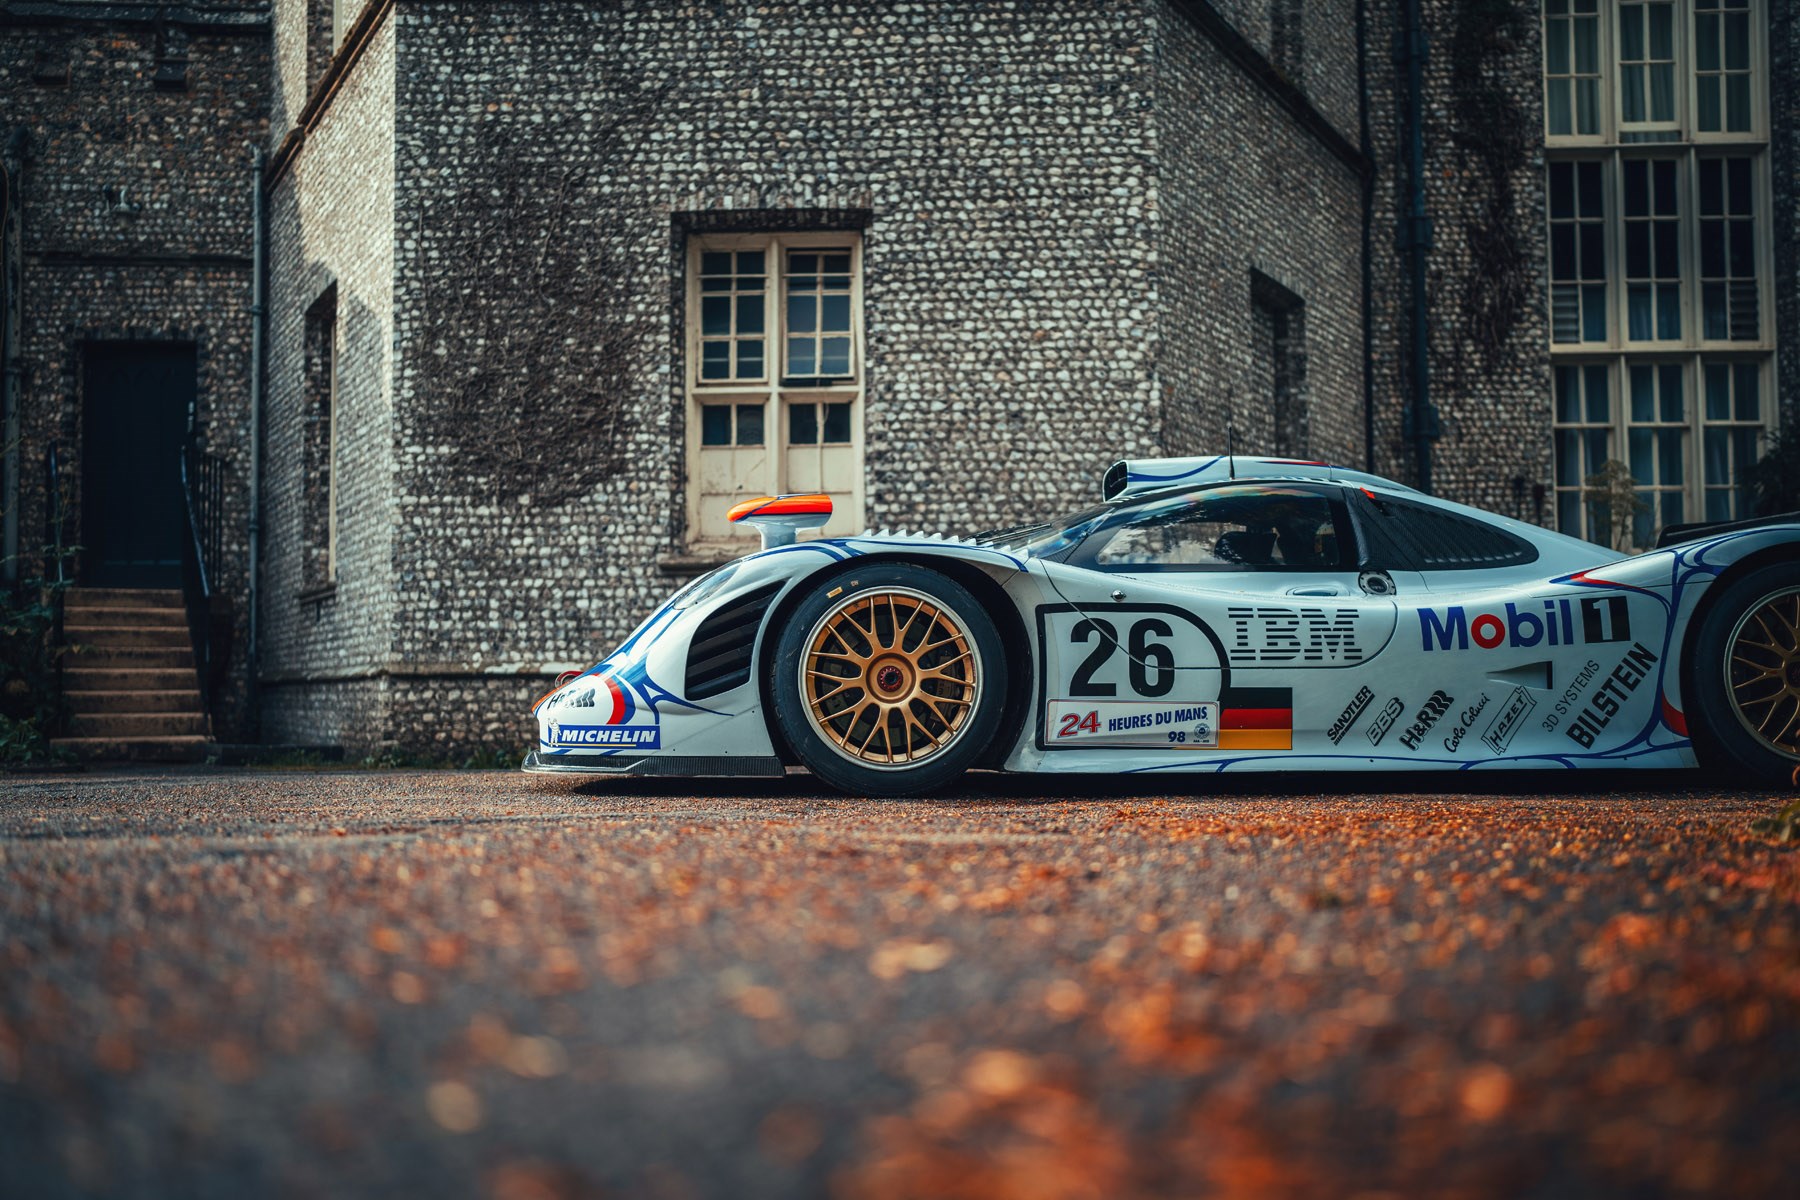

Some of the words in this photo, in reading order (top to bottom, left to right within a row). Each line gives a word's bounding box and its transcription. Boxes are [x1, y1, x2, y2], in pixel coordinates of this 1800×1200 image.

[1227, 606, 1363, 662] IBM
[1417, 599, 1574, 652] Mobil
[1069, 617, 1174, 698] 26
[1327, 685, 1372, 741] SANDTLER
[1366, 697, 1405, 747] BBS
[1490, 695, 1528, 747] HAZET
[1542, 713, 1559, 733] 3D
[1555, 659, 1600, 716] SYSTEMS
[1565, 642, 1659, 750] BILSTEIN
[562, 729, 656, 743] MICHELIN
[1057, 710, 1101, 739] 24
[1109, 713, 1153, 732] HEURES
[1155, 711, 1172, 726] DU
[1174, 706, 1208, 723] MANS
[1168, 731, 1186, 743] 98
[1443, 727, 1467, 753] Carlo
